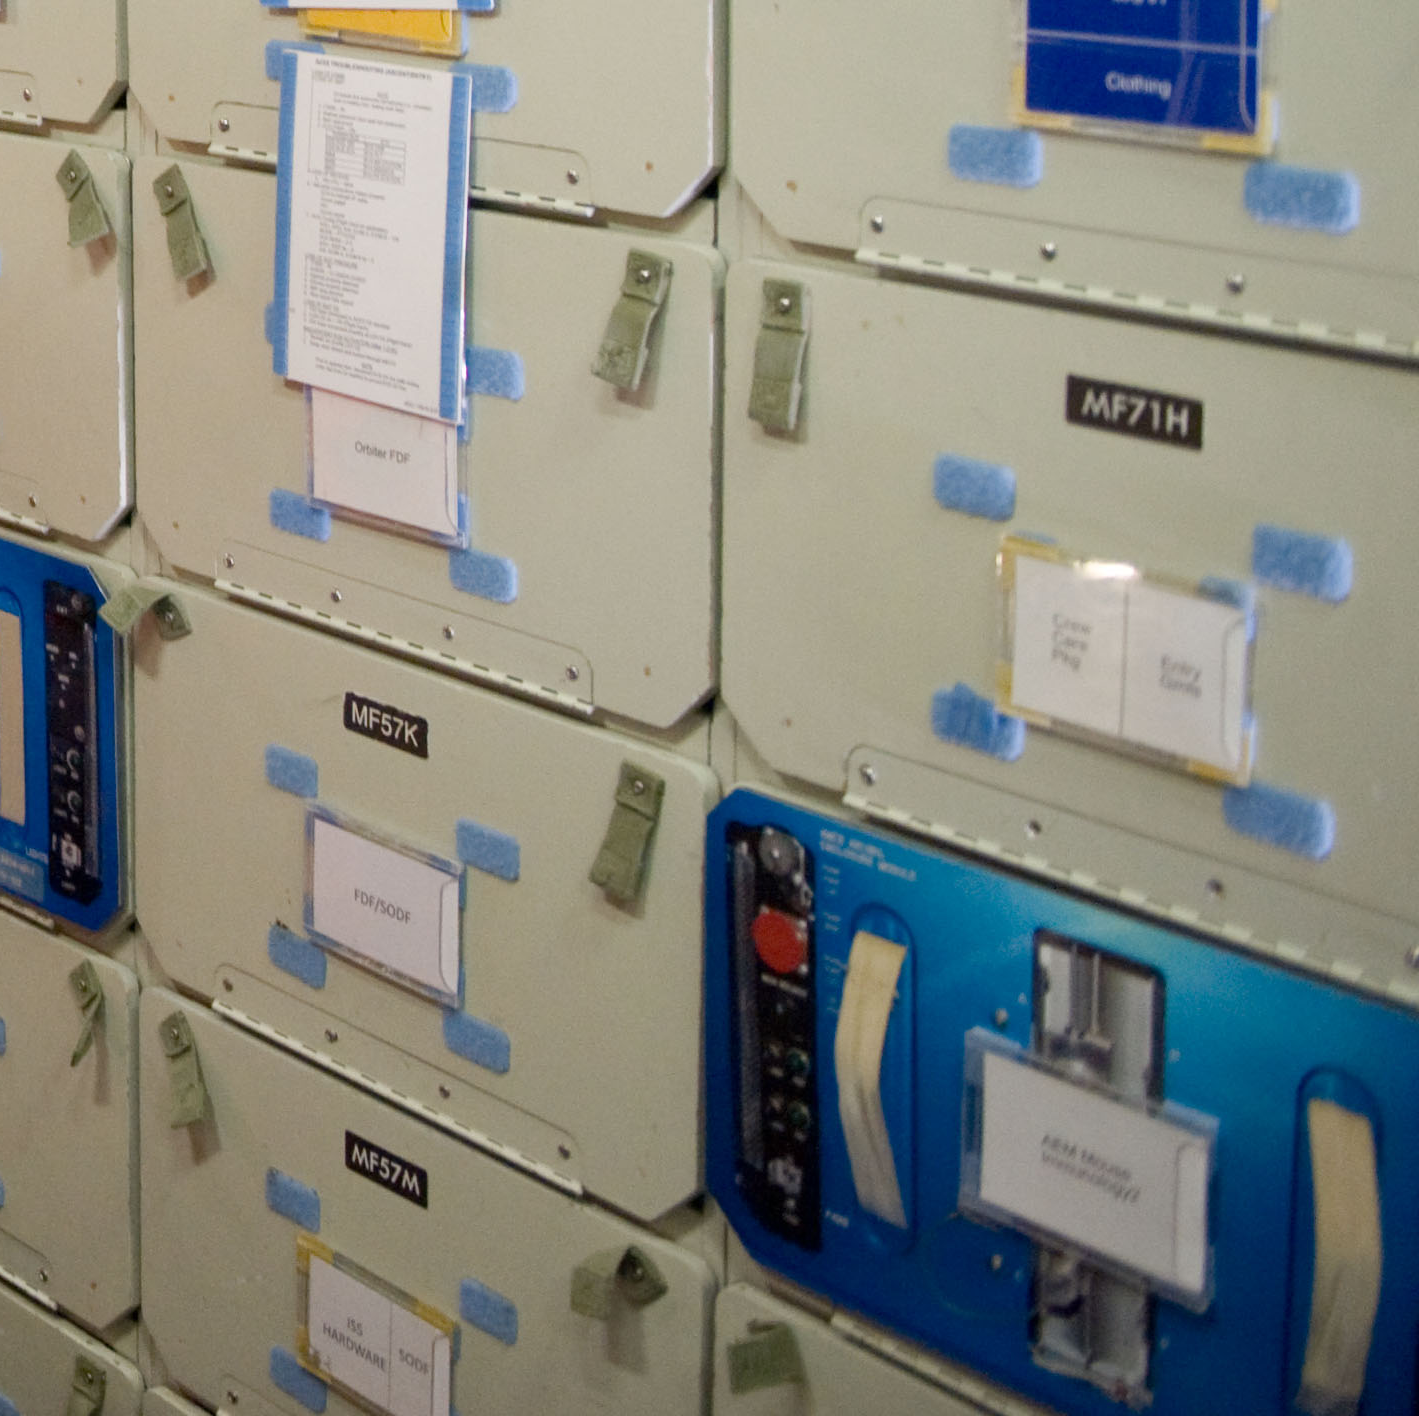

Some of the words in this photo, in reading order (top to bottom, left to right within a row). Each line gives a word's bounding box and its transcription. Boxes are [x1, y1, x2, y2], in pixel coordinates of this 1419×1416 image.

[1104, 70, 1172, 101] Clothing
[1080, 387, 1190, 439] MF71H
[354, 439, 387, 460] Orbiter
[389, 449, 411, 465] FDF
[350, 701, 420, 748] MF57K
[353, 887, 412, 926] FDF/SODF
[351, 1142, 421, 1198] MF57M
[345, 1316, 364, 1338] ISS
[322, 1322, 387, 1373] HARDWARE
[398, 1348, 430, 1376] SODF
